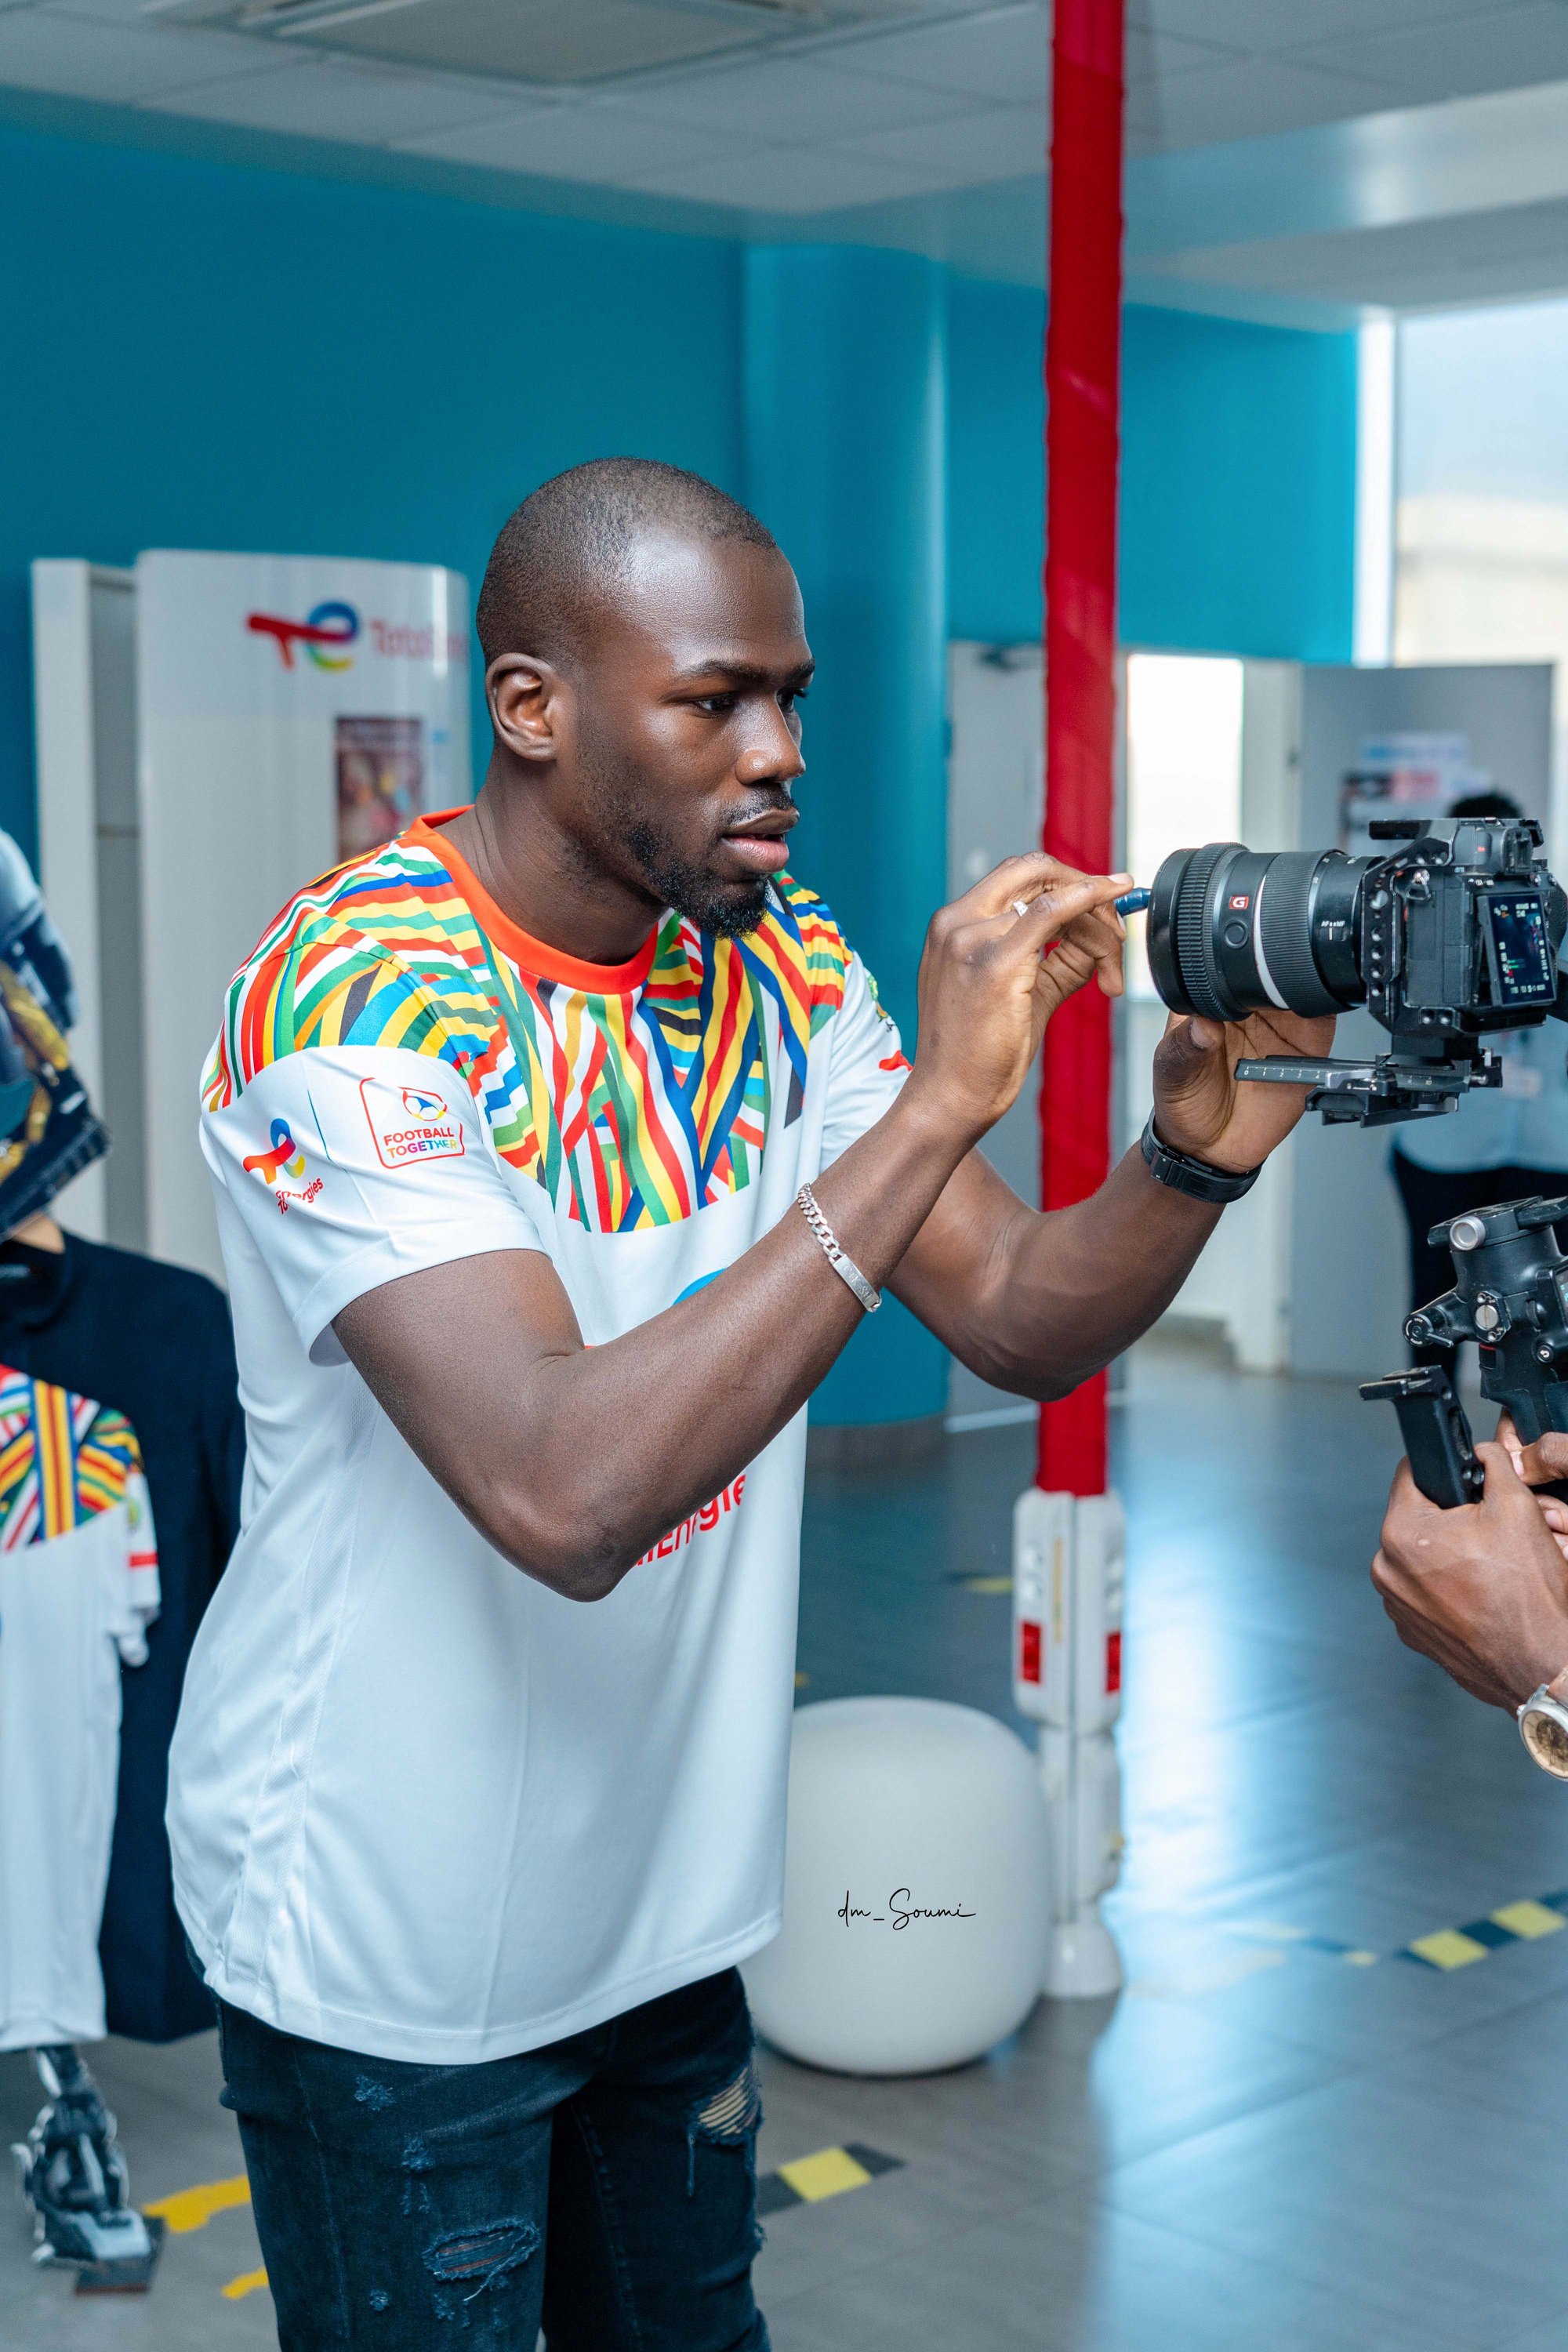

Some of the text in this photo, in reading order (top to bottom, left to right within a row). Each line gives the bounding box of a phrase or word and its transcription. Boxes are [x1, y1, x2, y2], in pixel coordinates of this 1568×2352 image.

[1232, 897, 1246, 908] G
[383, 1127, 455, 1146] FOOTBALL
[387, 1139, 458, 1159] TOGETHER
